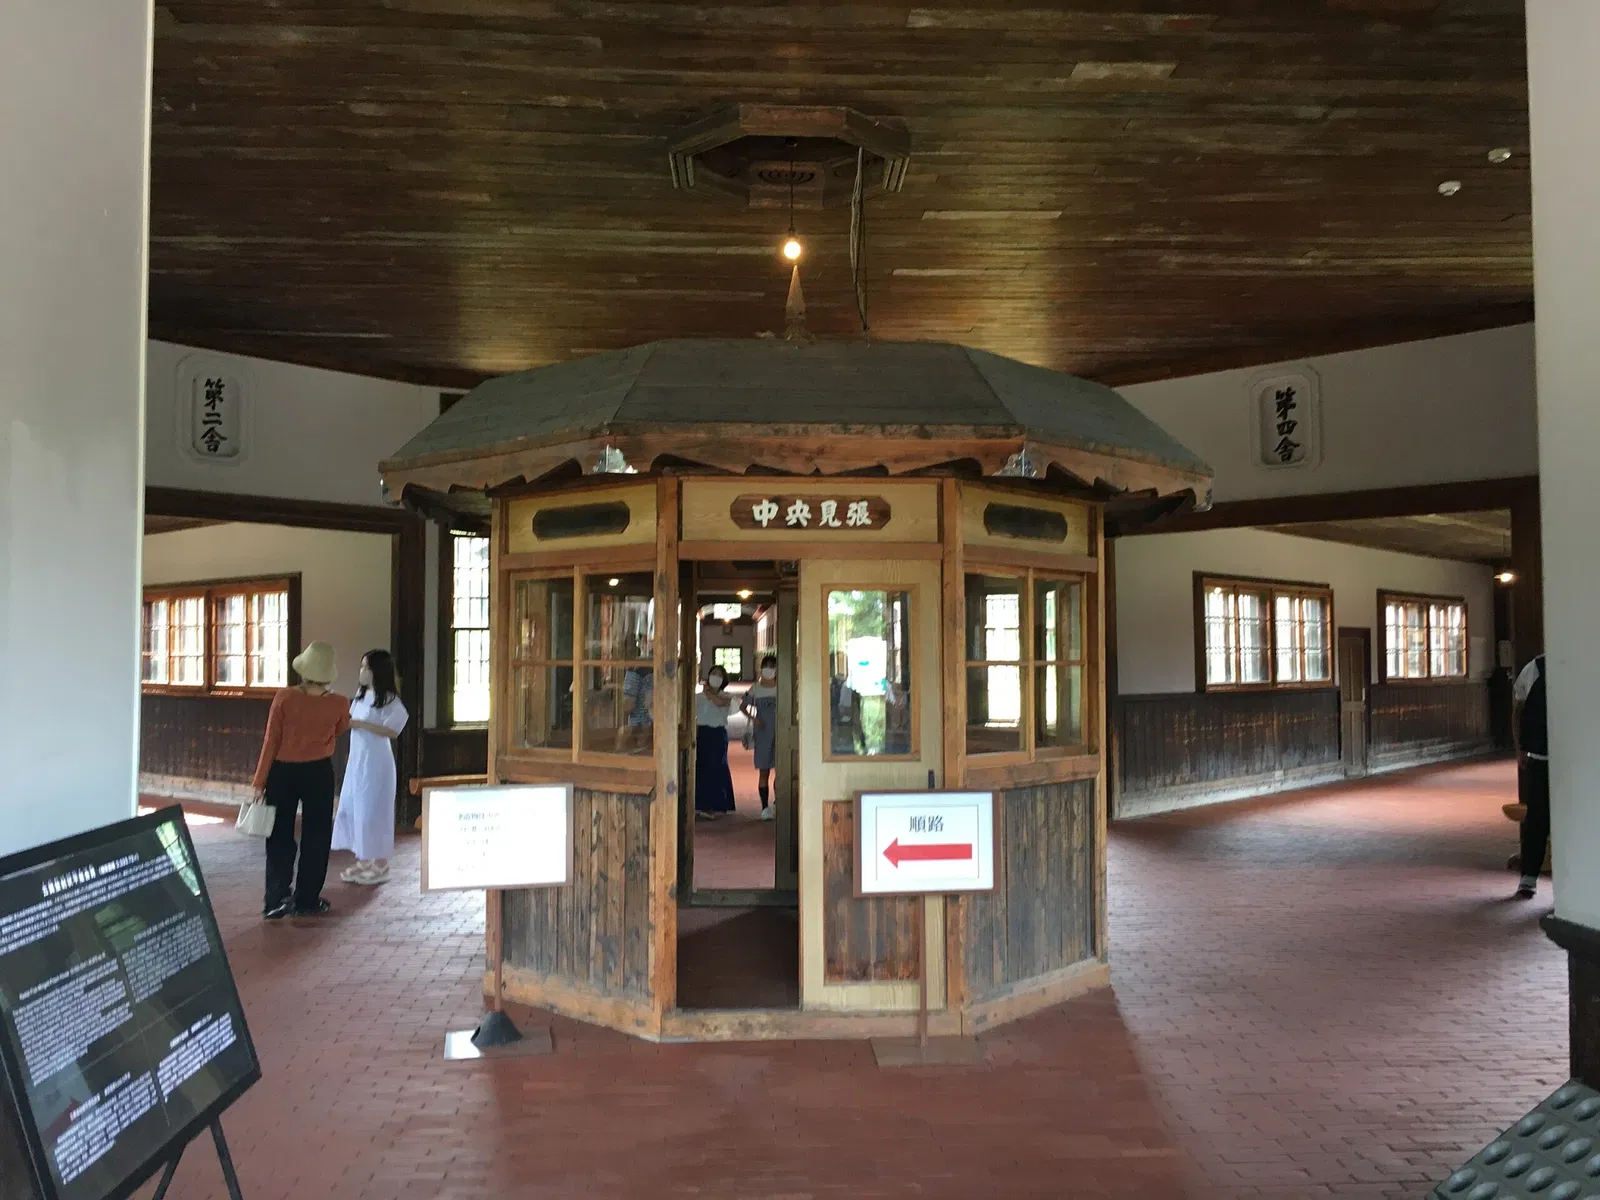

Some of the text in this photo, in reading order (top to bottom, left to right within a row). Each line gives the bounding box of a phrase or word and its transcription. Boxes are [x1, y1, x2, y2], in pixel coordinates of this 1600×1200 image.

[751, 498, 872, 528] 中央見張
[909, 815, 944, 833] 順路
